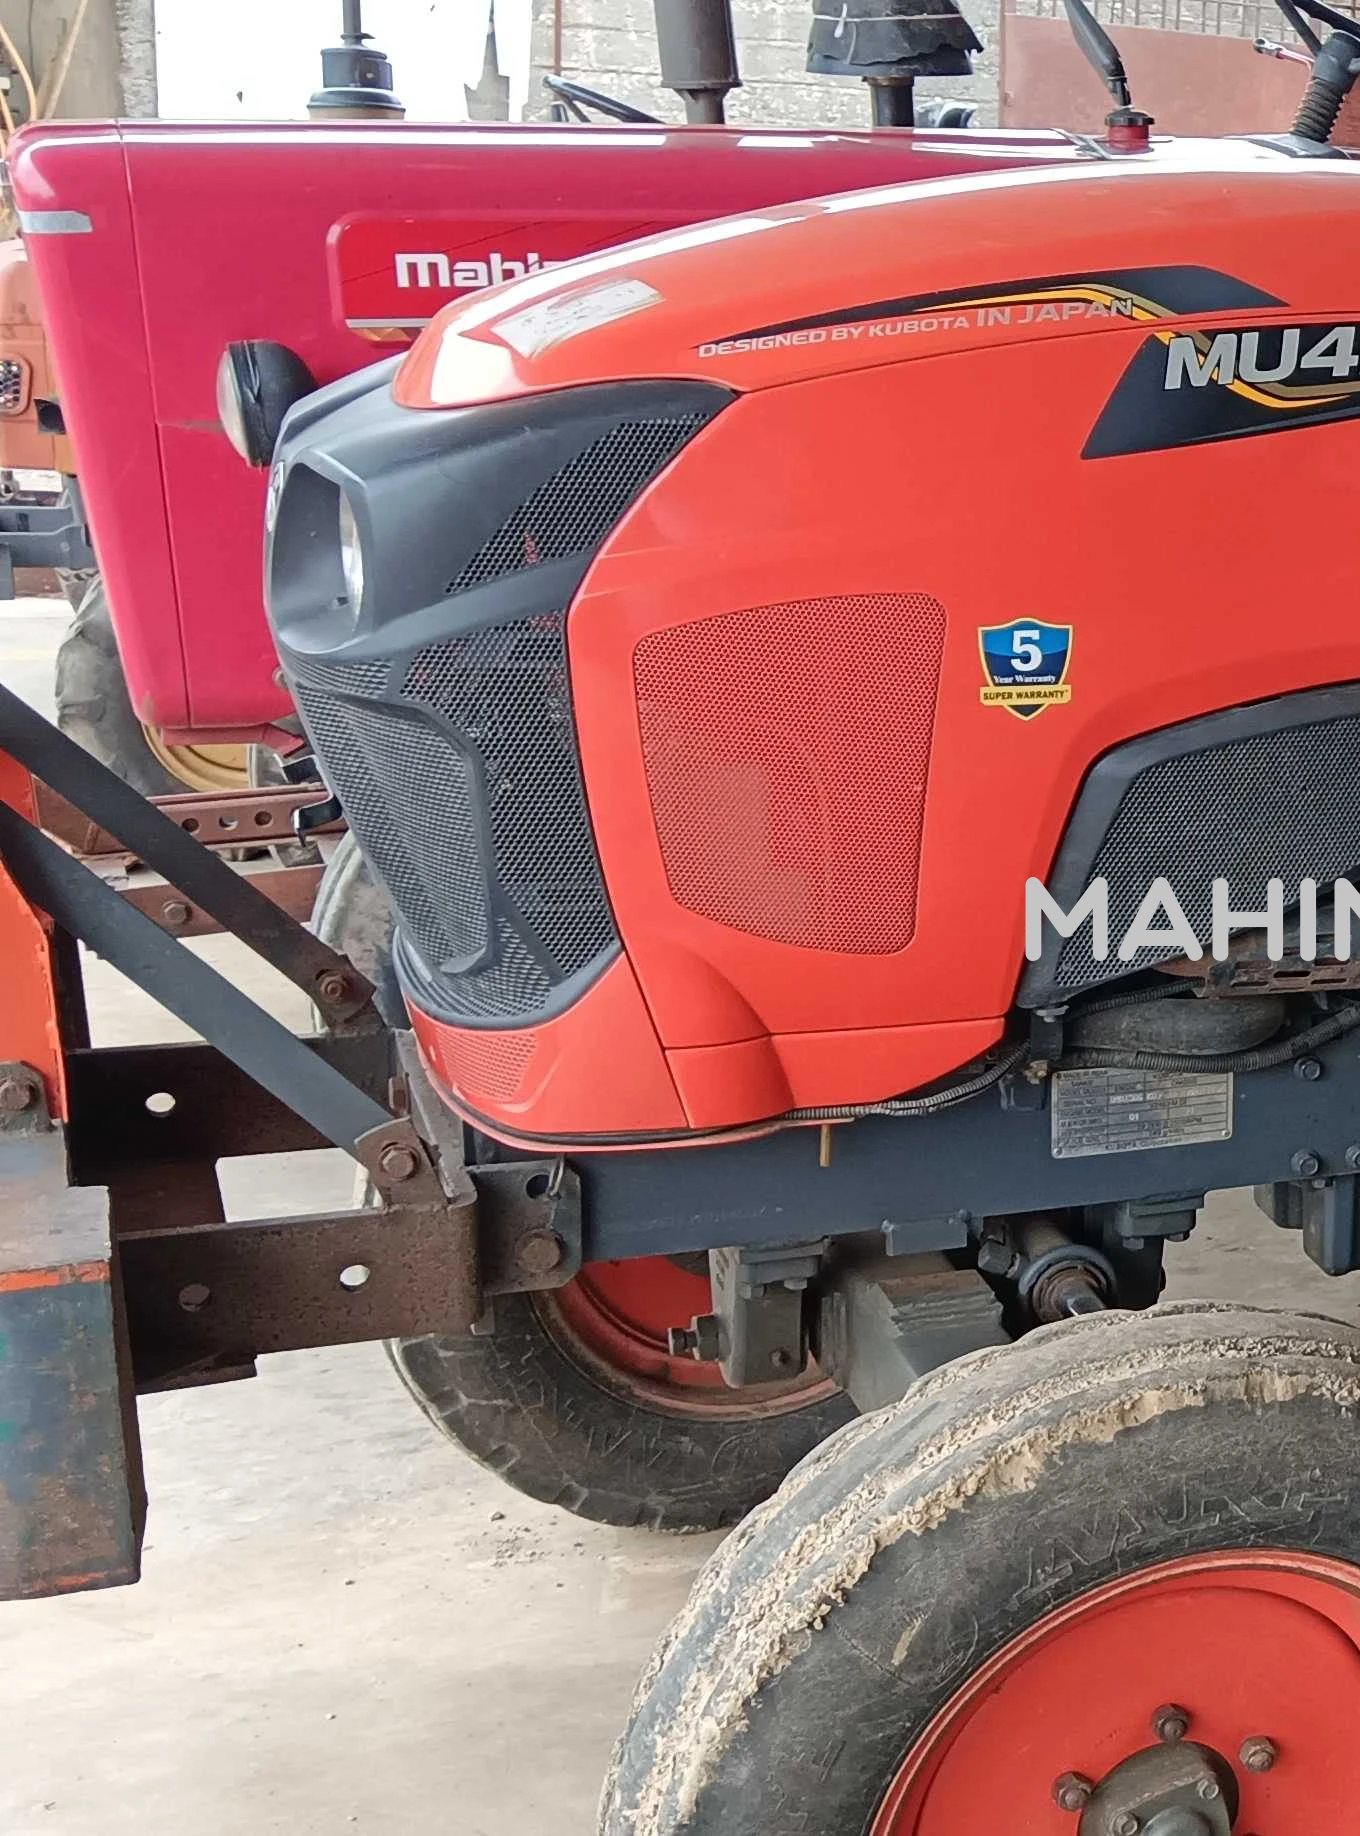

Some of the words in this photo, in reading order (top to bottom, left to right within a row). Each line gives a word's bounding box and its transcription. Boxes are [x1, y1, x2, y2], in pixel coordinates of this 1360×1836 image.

[698, 330, 826, 358] DESIGNED
[831, 326, 865, 341] BY
[867, 316, 970, 338] KUBOTA
[976, 309, 1010, 327] IN
[1017, 297, 1134, 325] JAPAN
[1010, 629, 1042, 672] 5
[993, 675, 1014, 684] Year
[1015, 674, 1056, 684] Warranty
[983, 691, 1013, 701] SUPER
